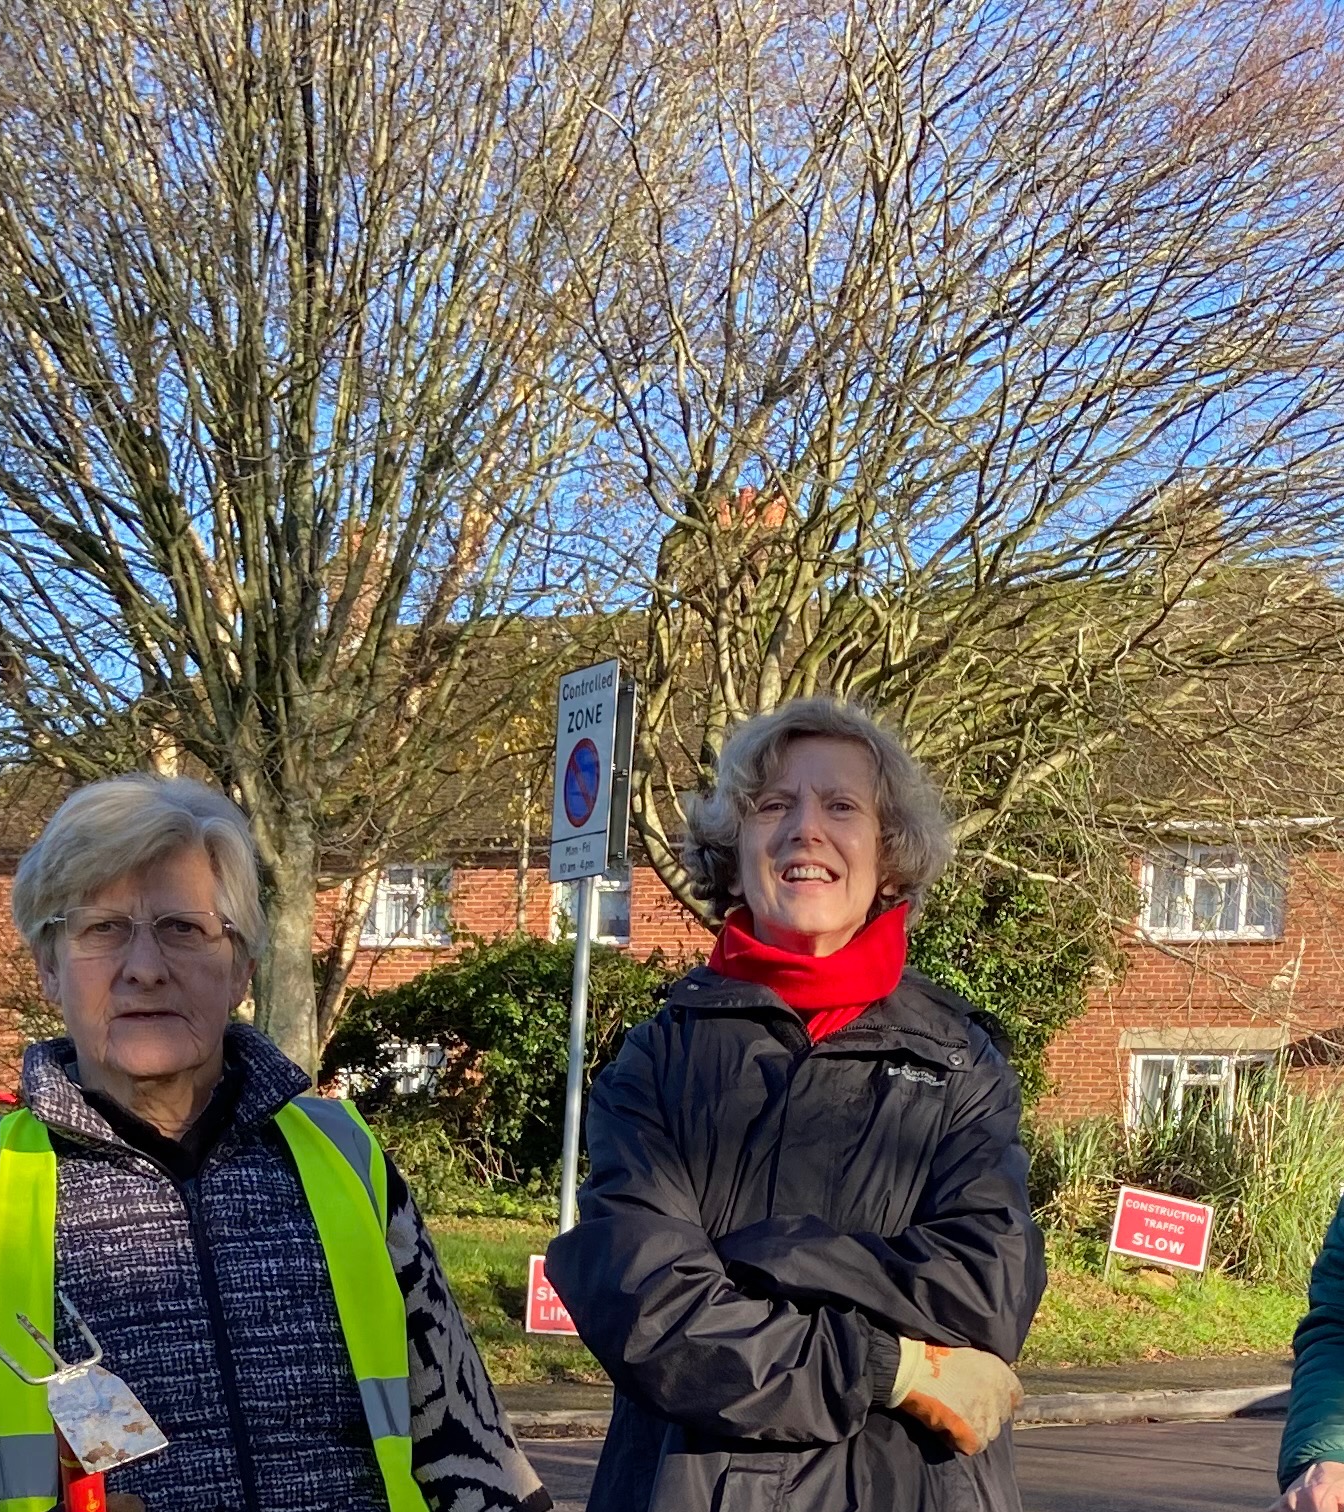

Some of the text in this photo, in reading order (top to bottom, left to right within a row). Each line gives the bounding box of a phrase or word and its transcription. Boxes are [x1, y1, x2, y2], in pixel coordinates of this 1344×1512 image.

[562, 670, 614, 701] Controlled
[567, 703, 603, 733] ZONE
[1125, 1199, 1205, 1225] CONSTRUCTION
[1144, 1217, 1185, 1235] TRAFFIC
[1132, 1232, 1185, 1255] SLOW
[540, 1306, 572, 1321] LIM
